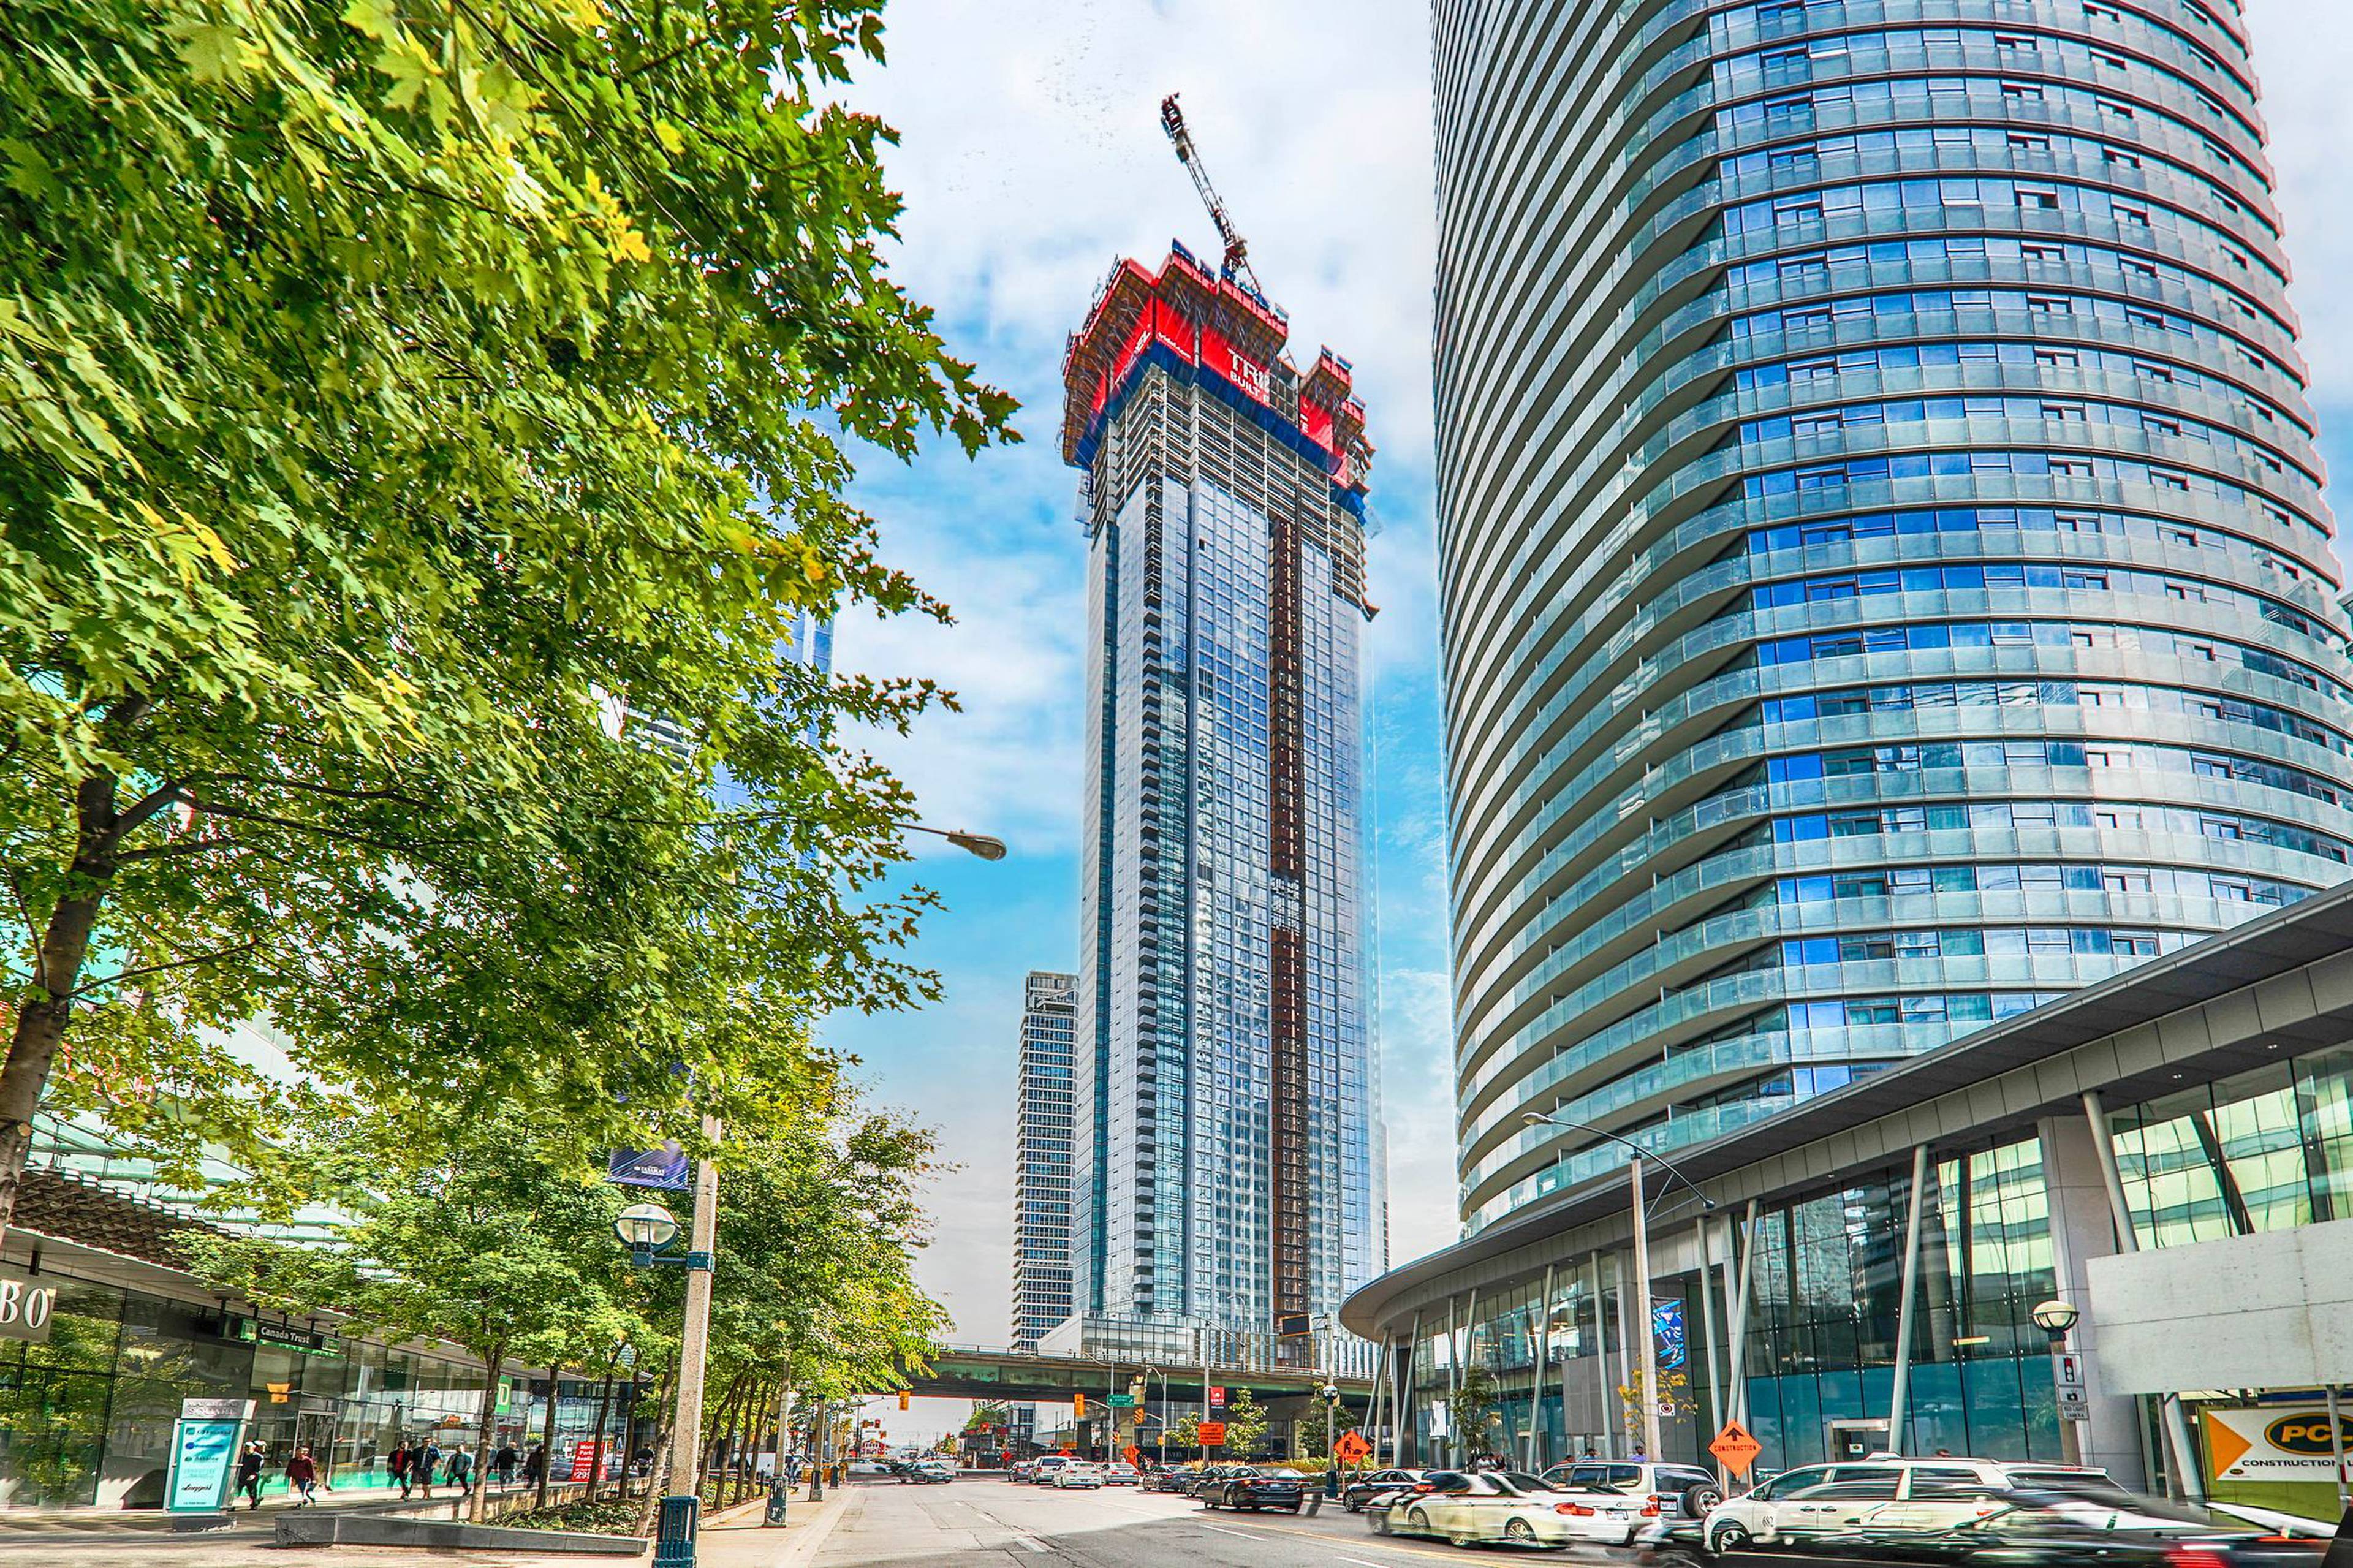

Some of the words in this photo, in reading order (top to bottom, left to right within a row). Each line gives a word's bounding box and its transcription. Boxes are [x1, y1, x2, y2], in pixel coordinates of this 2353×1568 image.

[1230, 370, 1260, 397] BUILT
[260, 1326, 289, 1340] Canada
[290, 1332, 309, 1344] Trust
